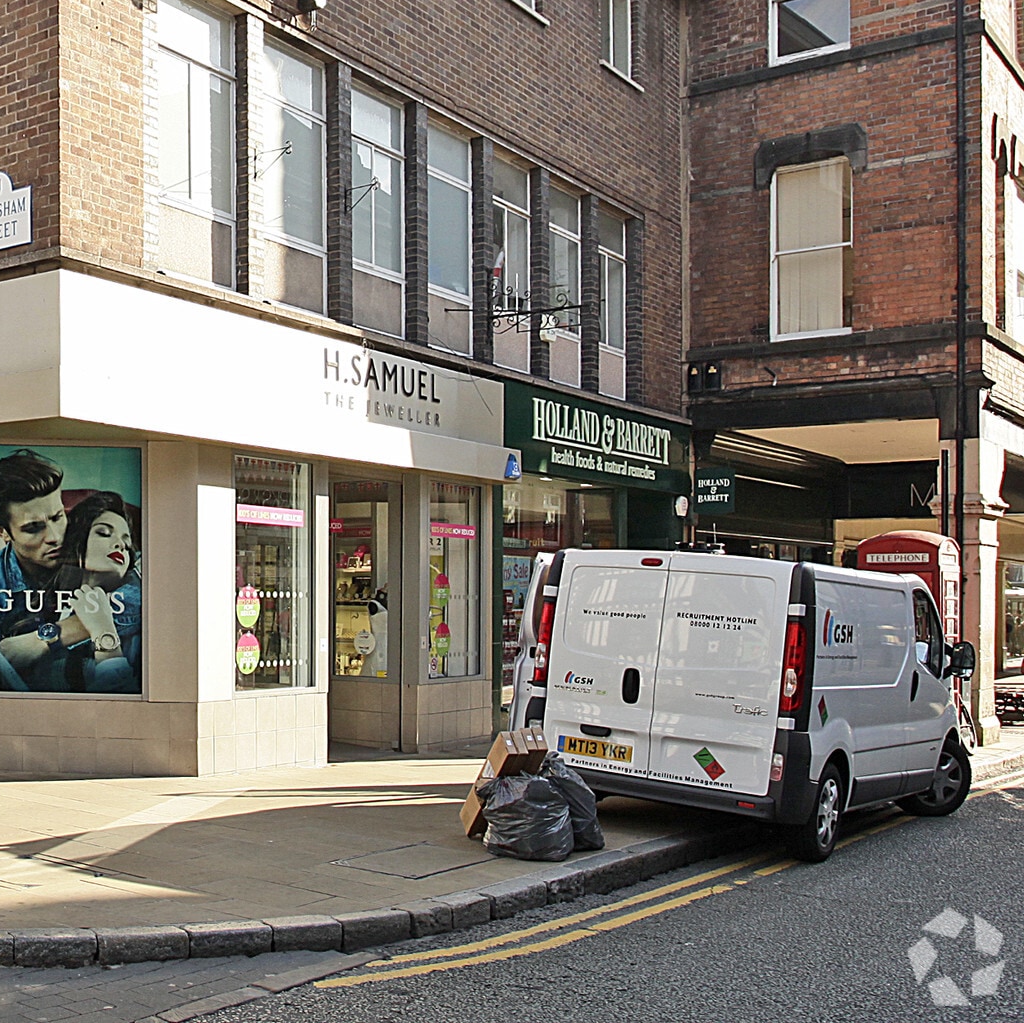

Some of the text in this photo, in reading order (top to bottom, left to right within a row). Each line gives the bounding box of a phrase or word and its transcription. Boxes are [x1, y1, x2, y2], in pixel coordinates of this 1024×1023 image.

[324, 347, 440, 404] H.SAMUEL
[324, 391, 440, 427] THE JEWELLER
[532, 397, 671, 465] HOLLAND & BARRETT
[551, 446, 656, 480] health foods & natural remedies
[698, 478, 730, 488] HOLLAND
[710, 486, 718, 494] &
[697, 493, 729, 503] BARRETT
[870, 554, 927, 562] TELEPHONE
[513, 563, 529, 579] Sale
[676, 612, 757, 625] RECRUITMENT HOTLINE
[834, 624, 854, 643] GSH
[574, 676, 594, 685] GSH
[733, 703, 768, 717] Trafic
[568, 738, 628, 760] MT13 YKR
[571, 757, 599, 767] Partners
[609, 764, 632, 774] Energy
[648, 770, 683, 781] Facilities
[684, 776, 733, 788] Management
